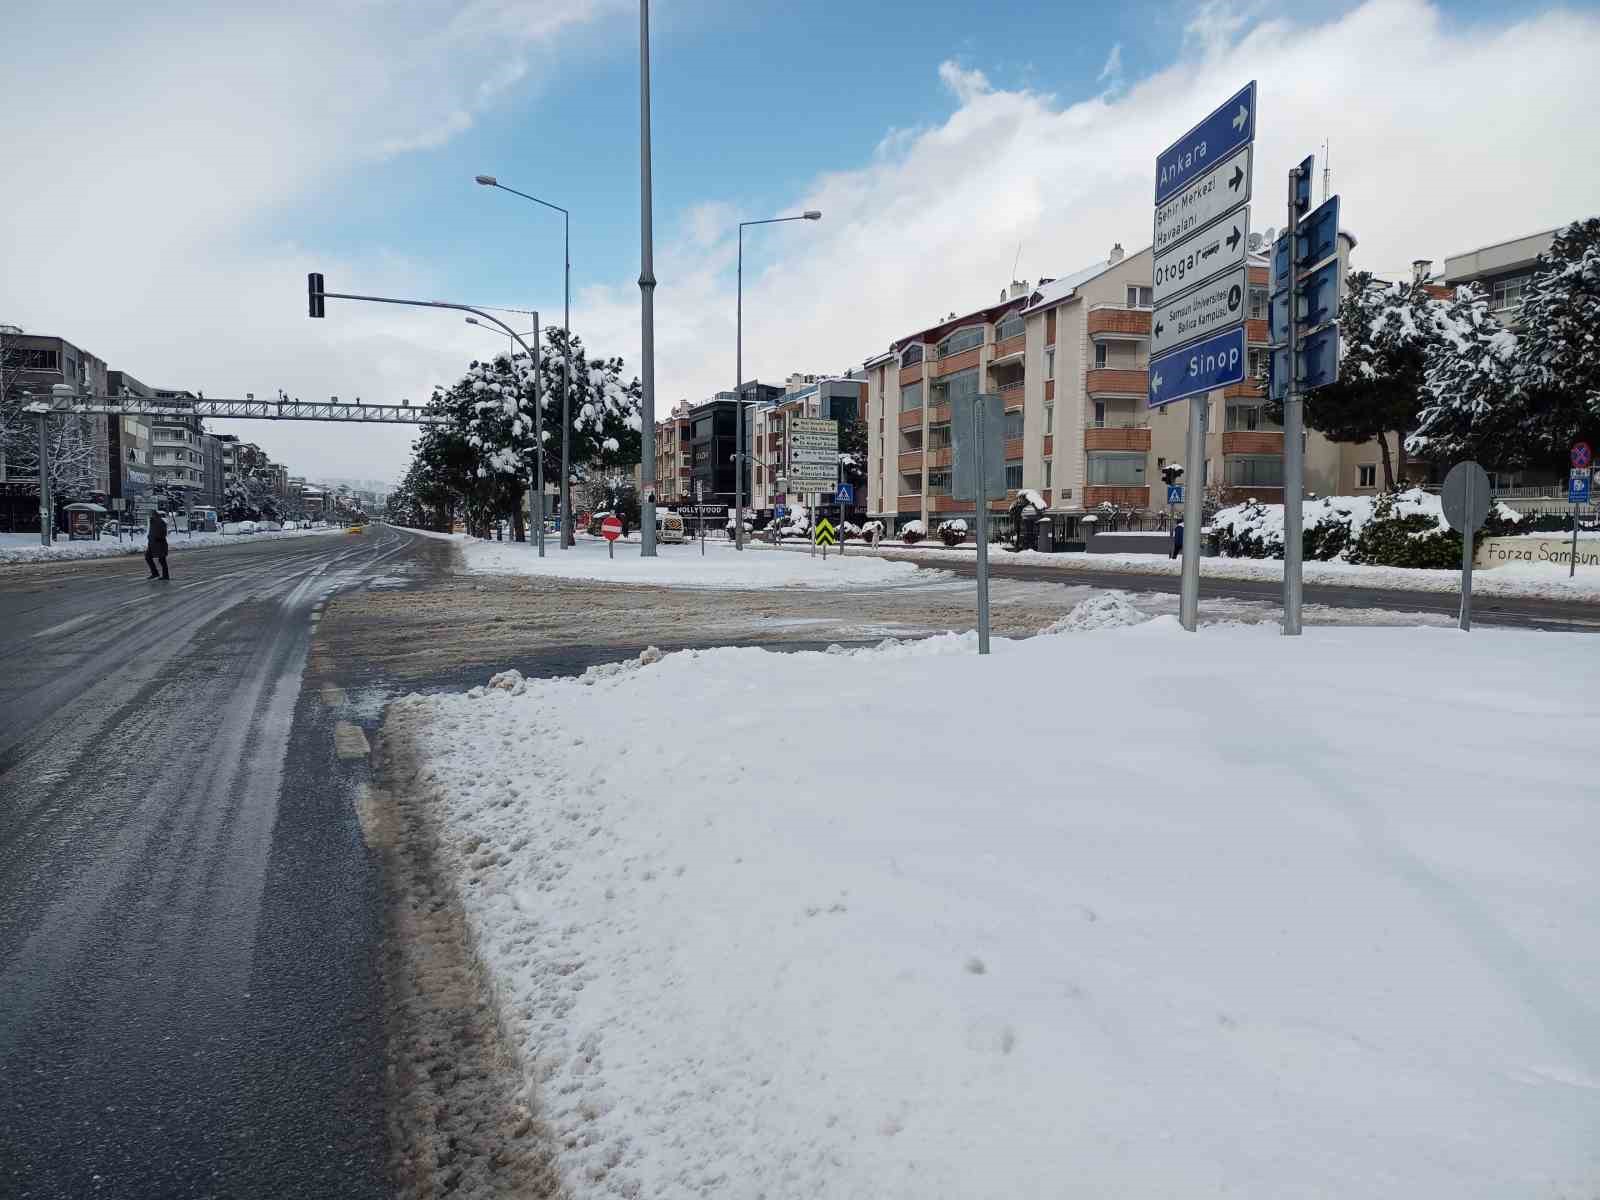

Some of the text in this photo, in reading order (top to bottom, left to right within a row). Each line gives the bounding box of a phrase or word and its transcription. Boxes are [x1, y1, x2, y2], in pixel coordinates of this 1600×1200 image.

[1160, 141, 1207, 187] Ankara
[1156, 249, 1201, 286] Otogar
[1169, 304, 1192, 321] Samsun
[1190, 347, 1239, 377] Sinop
[677, 506, 721, 514] HOLLYWOOD
[1488, 543, 1532, 561] Forza
